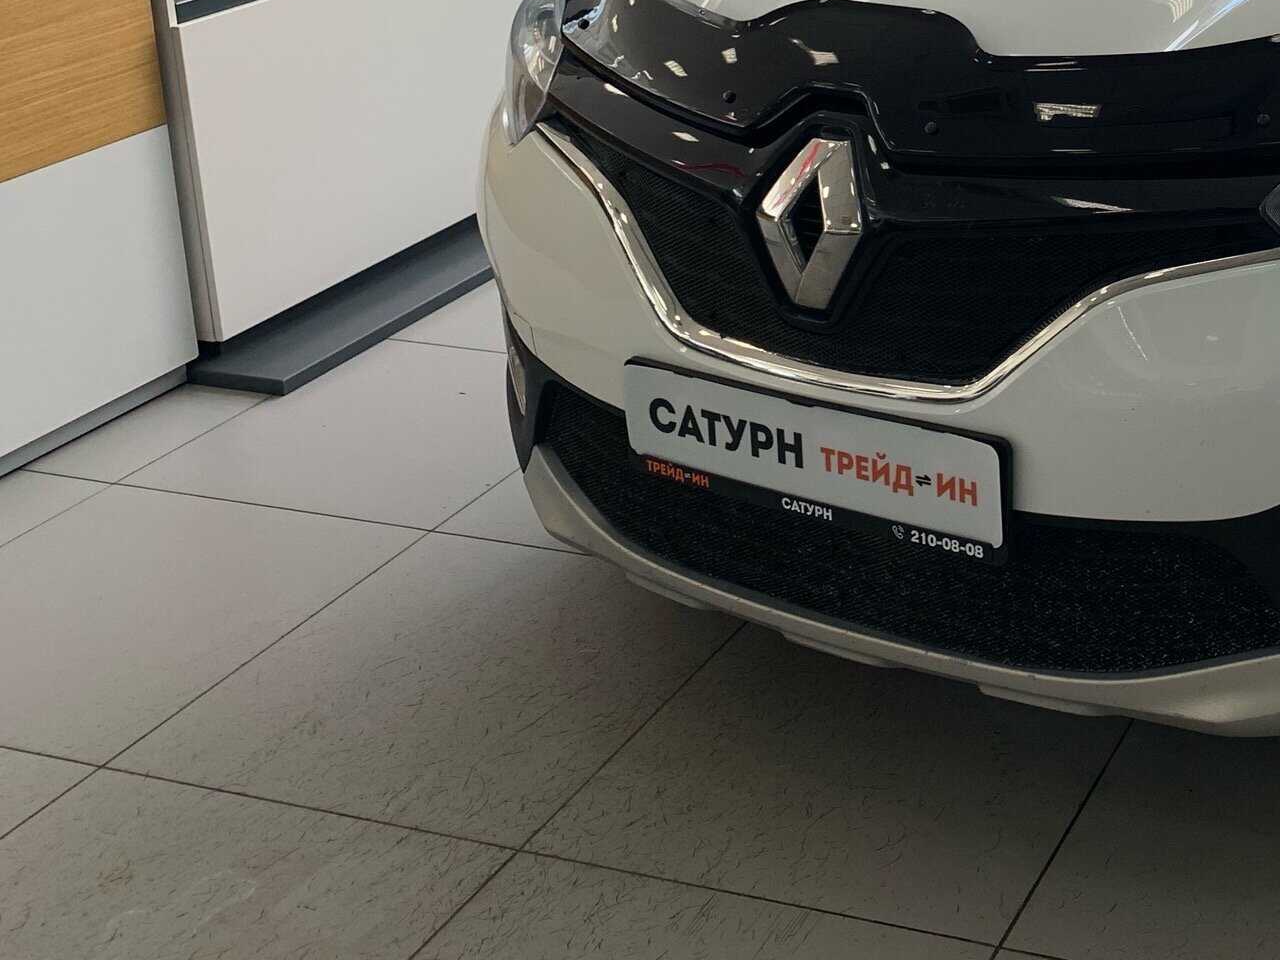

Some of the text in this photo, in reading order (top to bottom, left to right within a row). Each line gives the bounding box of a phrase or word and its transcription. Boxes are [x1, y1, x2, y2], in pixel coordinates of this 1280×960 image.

[649, 397, 804, 469] САТУРН
[781, 497, 833, 521] САТУРН
[910, 530, 984, 559] 210-08-08
